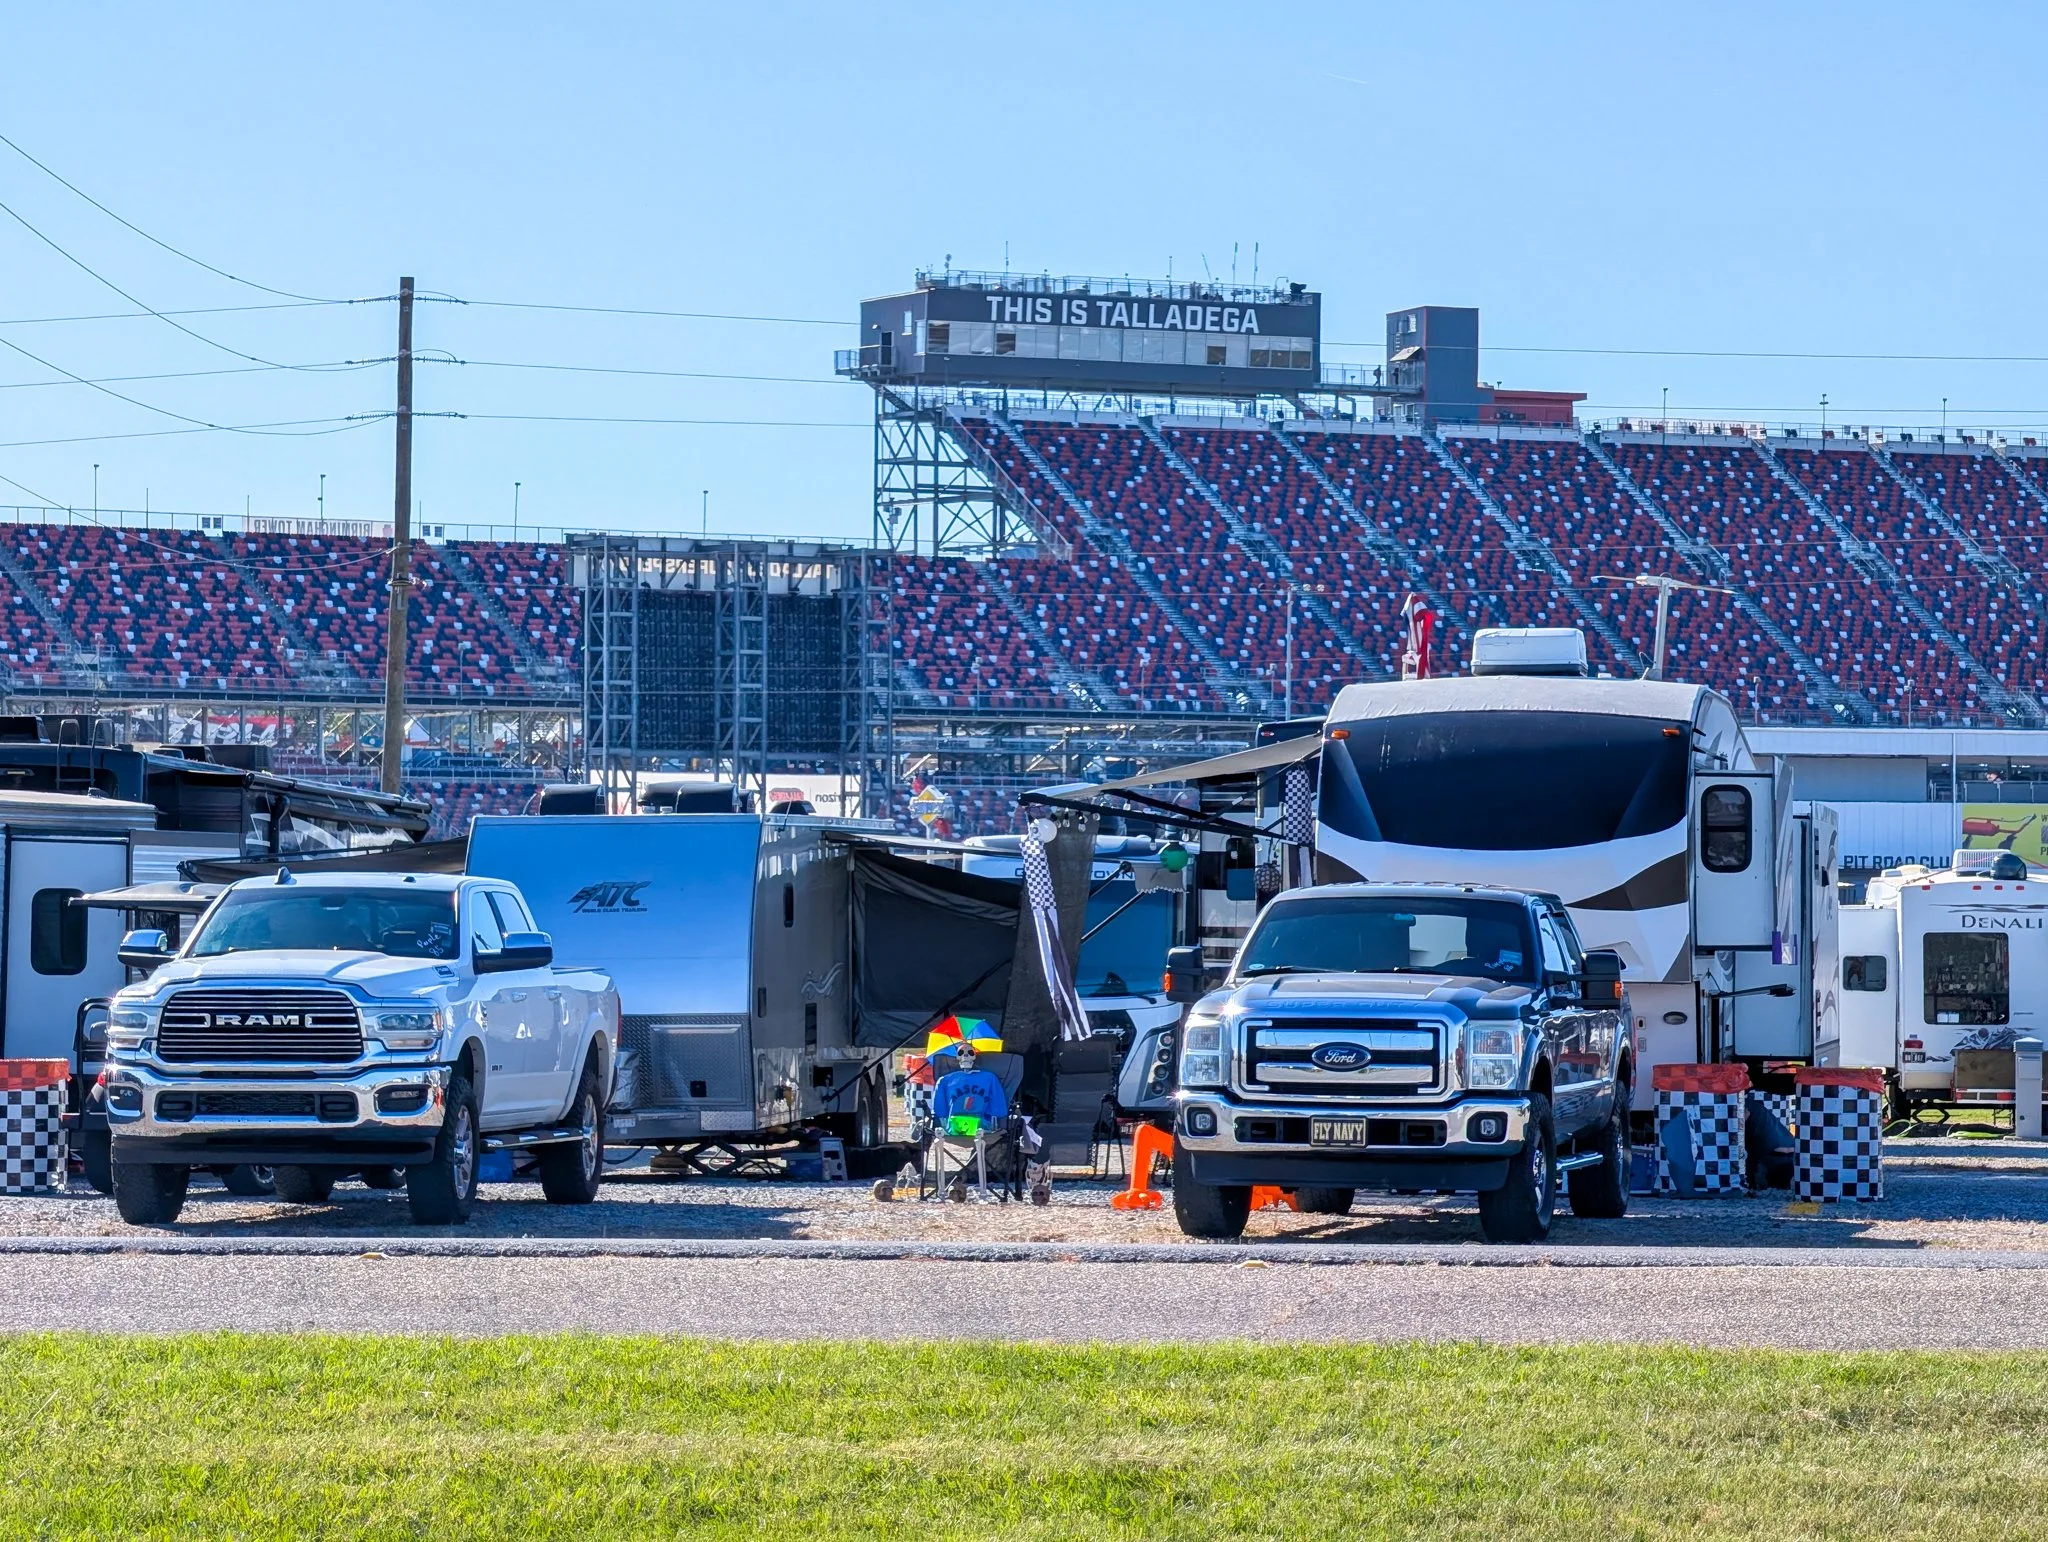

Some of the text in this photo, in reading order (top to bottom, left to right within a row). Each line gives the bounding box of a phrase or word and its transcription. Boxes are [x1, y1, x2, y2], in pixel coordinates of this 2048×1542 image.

[986, 295, 1260, 334] THIS IS TALLADEGA
[1843, 855, 1950, 869] PIT ROAD CLU
[591, 881, 653, 907] ATC
[1961, 914, 2043, 929] DENALI
[215, 1014, 300, 1026] RAM
[1324, 1049, 1357, 1064] Ford
[1313, 1121, 1363, 1141] FLY NAVY
